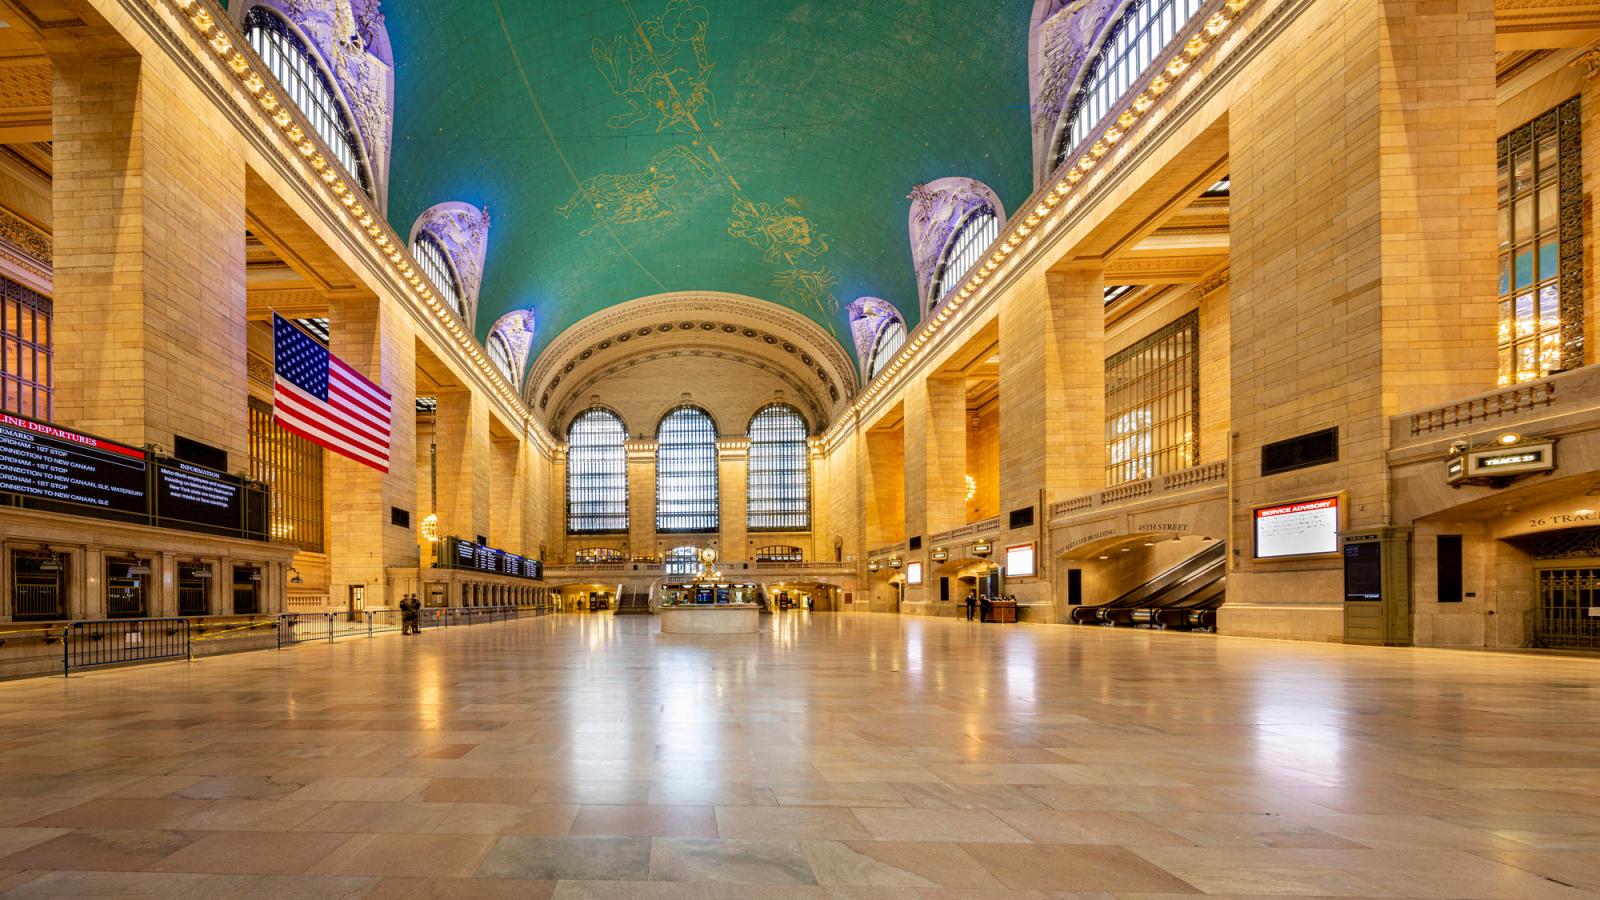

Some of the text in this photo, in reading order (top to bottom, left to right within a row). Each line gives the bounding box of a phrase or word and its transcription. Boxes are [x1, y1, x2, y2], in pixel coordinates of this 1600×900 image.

[29, 421, 97, 446] DEPARTURES
[50, 449, 68, 457] STOP
[54, 458, 70, 466] NEW
[70, 461, 96, 472] CANAAN
[1485, 456, 1521, 466] TRACK
[160, 468, 187, 479] Metro-North
[180, 463, 220, 479] INFORMATION
[54, 475, 70, 483] NEW
[110, 486, 144, 497] WATERBURY
[54, 491, 70, 499] NEW
[1261, 501, 1331, 516] SERVICE ADVISORY
[1529, 511, 1600, 527] 26 TRAC
[1157, 523, 1189, 531] STREET
